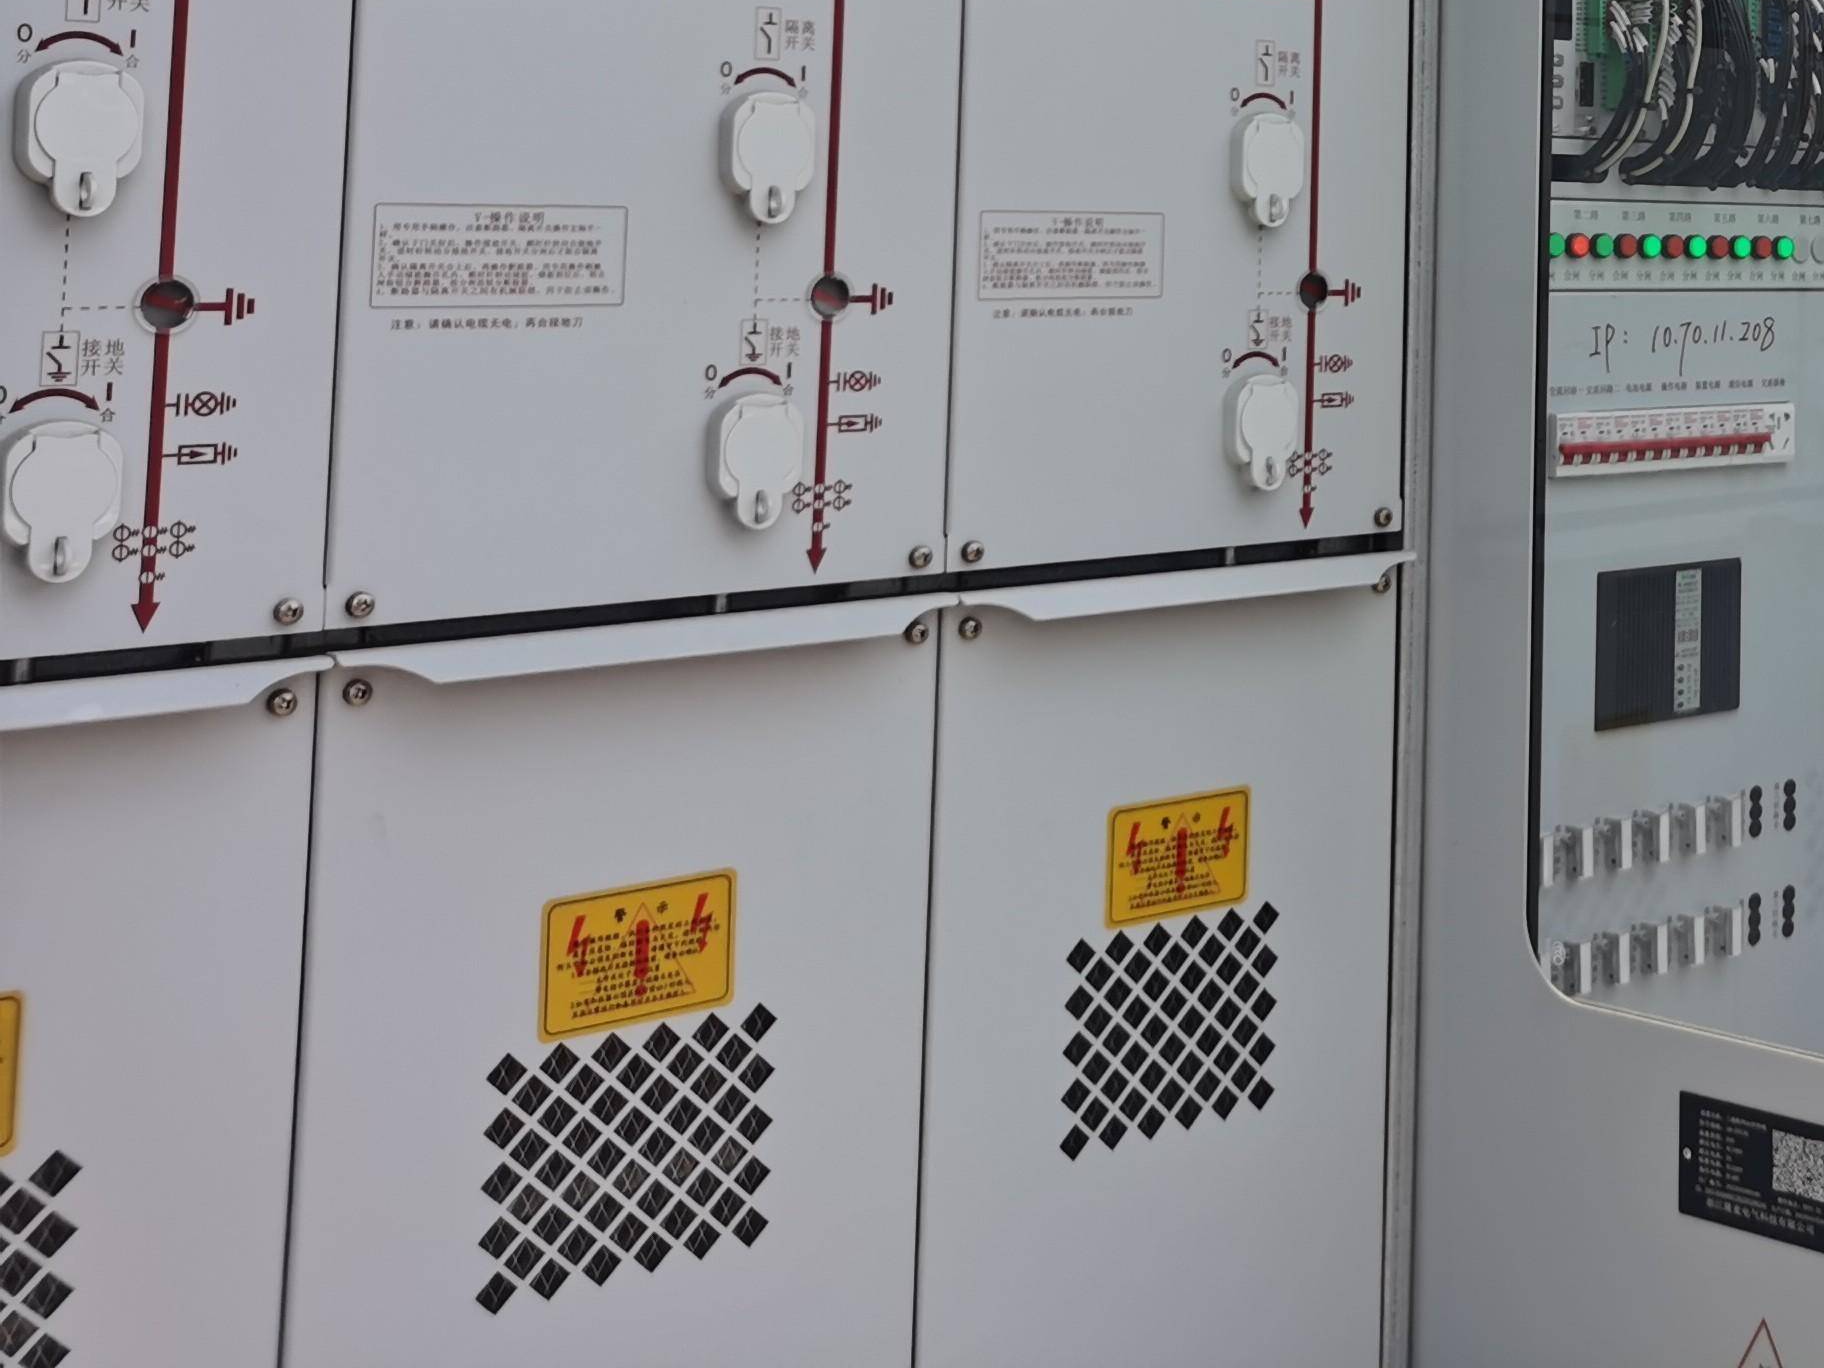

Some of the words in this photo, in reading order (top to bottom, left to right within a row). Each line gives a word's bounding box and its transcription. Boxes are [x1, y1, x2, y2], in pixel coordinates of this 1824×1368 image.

[16, 48, 32, 64] 分
[125, 54, 140, 69] 合
[1651, 316, 1776, 376] 10.70.11.208
[100, 408, 115, 422] 合
